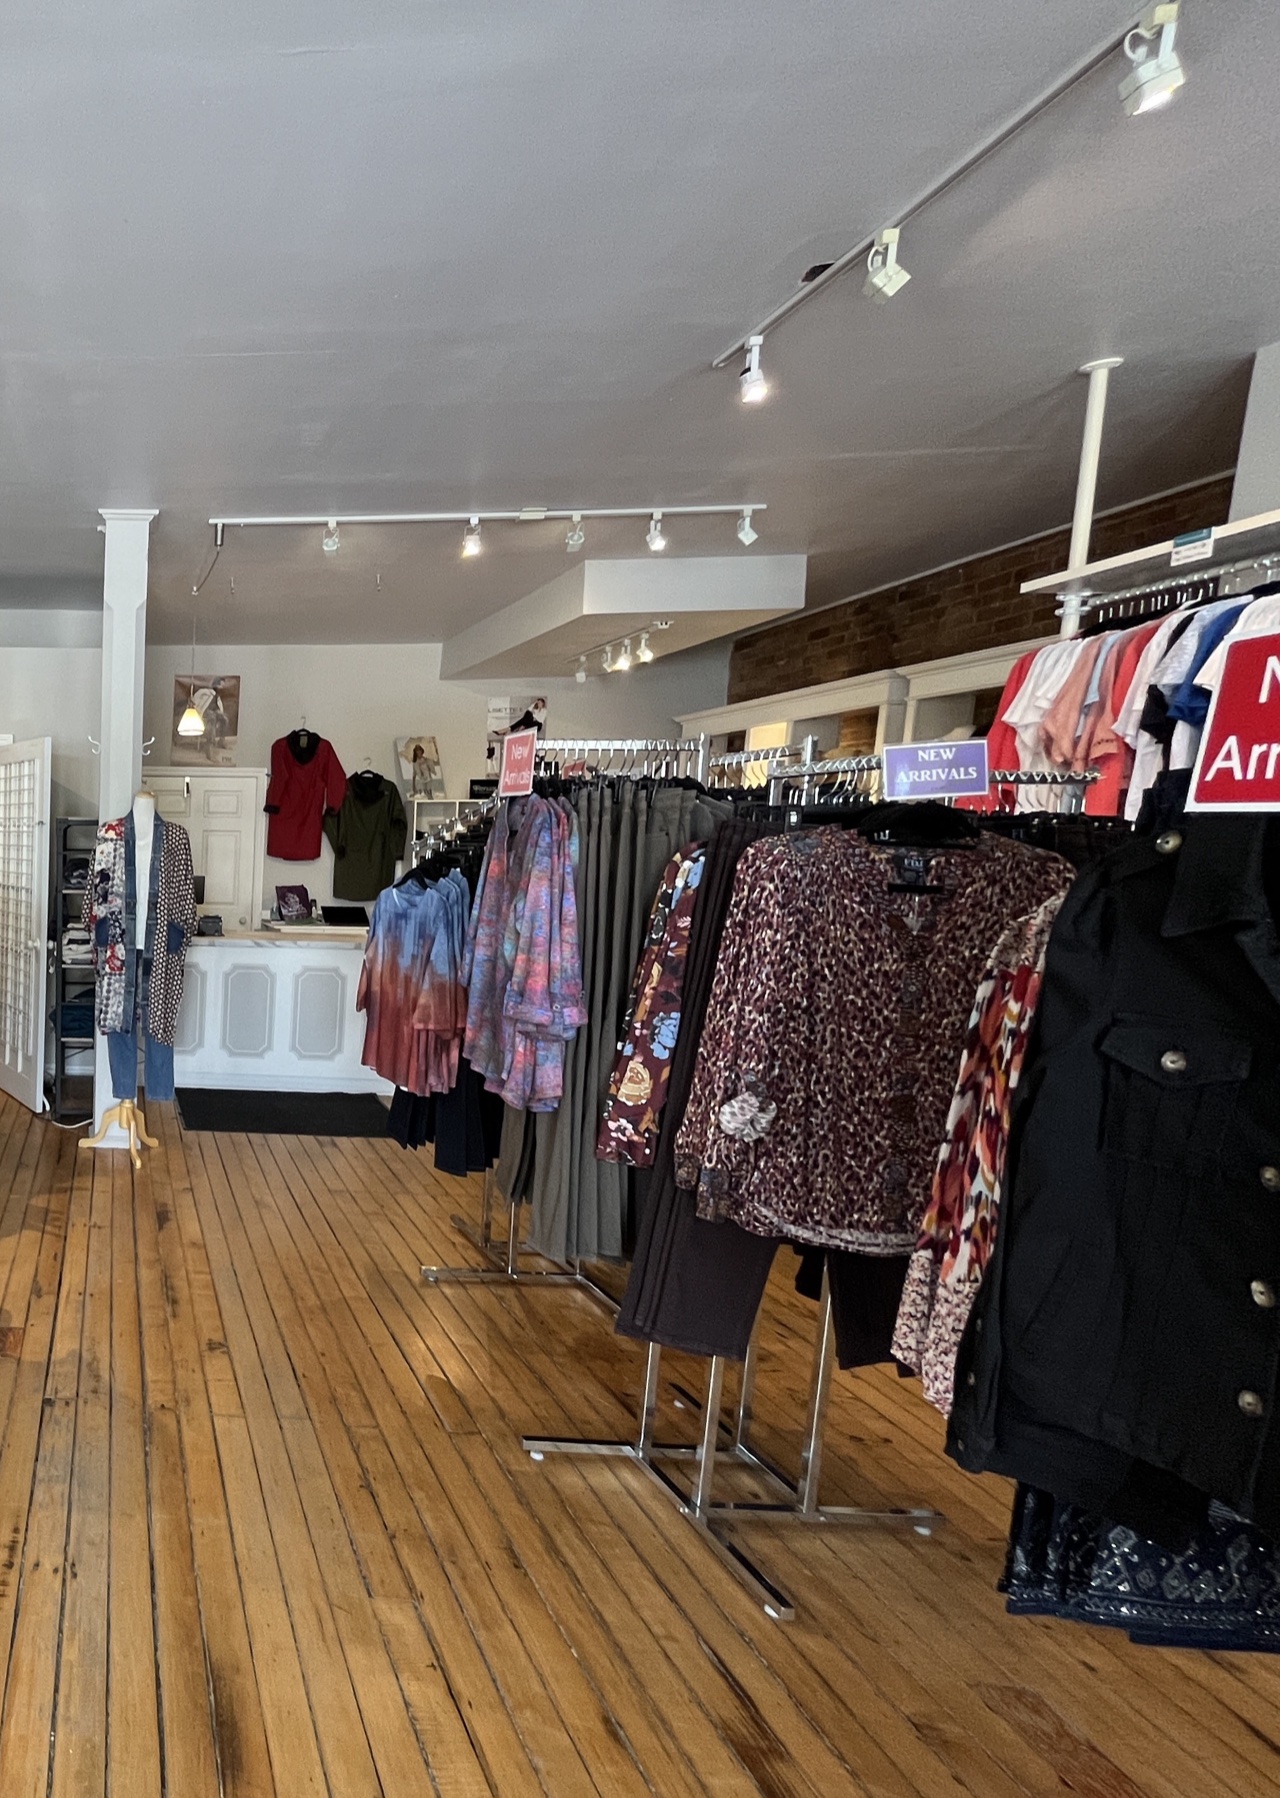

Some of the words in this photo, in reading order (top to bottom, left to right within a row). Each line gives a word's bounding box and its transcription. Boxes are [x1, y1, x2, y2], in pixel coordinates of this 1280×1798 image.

[511, 743, 529, 761] New
[917, 747, 957, 762] NEW
[504, 767, 531, 786] Arrivals
[896, 766, 978, 783] ARRIVALS
